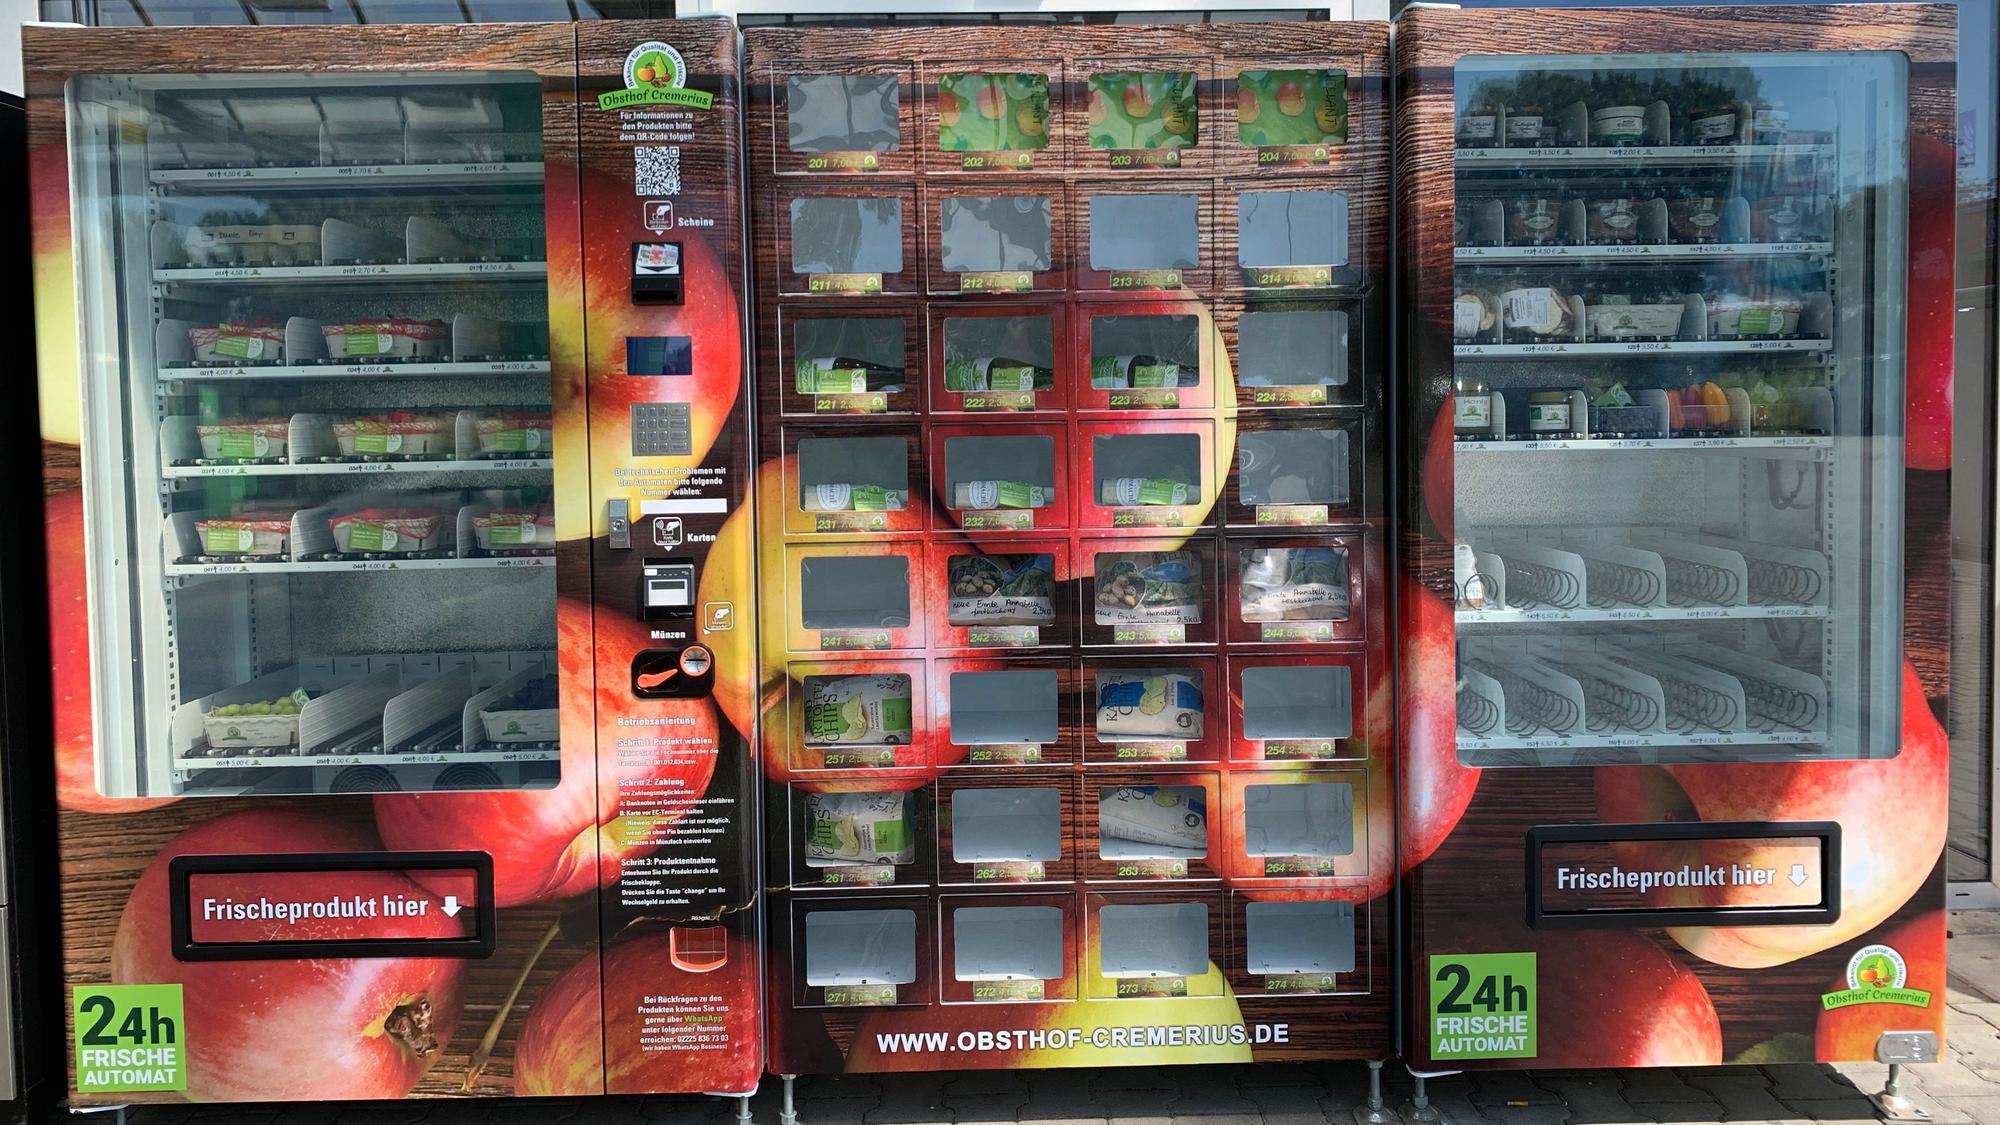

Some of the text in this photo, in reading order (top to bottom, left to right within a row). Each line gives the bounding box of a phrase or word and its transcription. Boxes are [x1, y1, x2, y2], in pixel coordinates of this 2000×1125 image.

[640, 44, 666, 52] Qualität
[603, 90, 709, 106] Obsthof Cremerius
[669, 132, 695, 142] folgen!
[1111, 156, 1132, 164] 203
[1260, 152, 1279, 161] 204
[809, 159, 828, 168] 201
[964, 157, 983, 166] 202
[678, 217, 714, 226] Scheine
[963, 279, 983, 287] 212
[1260, 274, 1280, 283] 214
[1256, 393, 1276, 402] 224
[817, 400, 836, 409] 221
[675, 467, 713, 475] Problemen
[692, 477, 723, 486] folgende
[1115, 515, 1134, 524] 233
[818, 520, 836, 529] 231
[688, 534, 716, 542] Karten
[651, 630, 686, 639] Münzen
[970, 633, 989, 642] 242
[1116, 631, 1136, 640] 243
[618, 717, 696, 726] Betriebsanleitung
[823, 694, 840, 741] CHIPS
[1266, 746, 1285, 755] 254
[826, 755, 844, 763] 251
[818, 810, 834, 854] CHIPS
[654, 857, 716, 865] Produktentnahme
[826, 874, 844, 883] 261
[977, 870, 996, 879] 262
[1557, 864, 1776, 893] Frischeprodukt hier
[203, 895, 428, 924] Frischeprodukt hier
[1269, 980, 1287, 989] 274
[1436, 963, 1528, 1014] 24h
[658, 996, 698, 1004] Rückfragen
[828, 993, 846, 1002] 271
[1826, 990, 1926, 1006] Obsthof Cremerius
[79, 995, 175, 1046] 24h
[684, 1015, 723, 1023] WhatsApp
[661, 1026, 695, 1034] folgender
[1437, 1016, 1527, 1035] FRISCHE
[876, 1024, 1289, 1053] WWW.OBSTHOF-CREMERIUS.DE
[1437, 1036, 1528, 1053] AUTOMAT
[82, 1048, 176, 1066] FRISCHE
[84, 1070, 176, 1086] AUTOMAT
